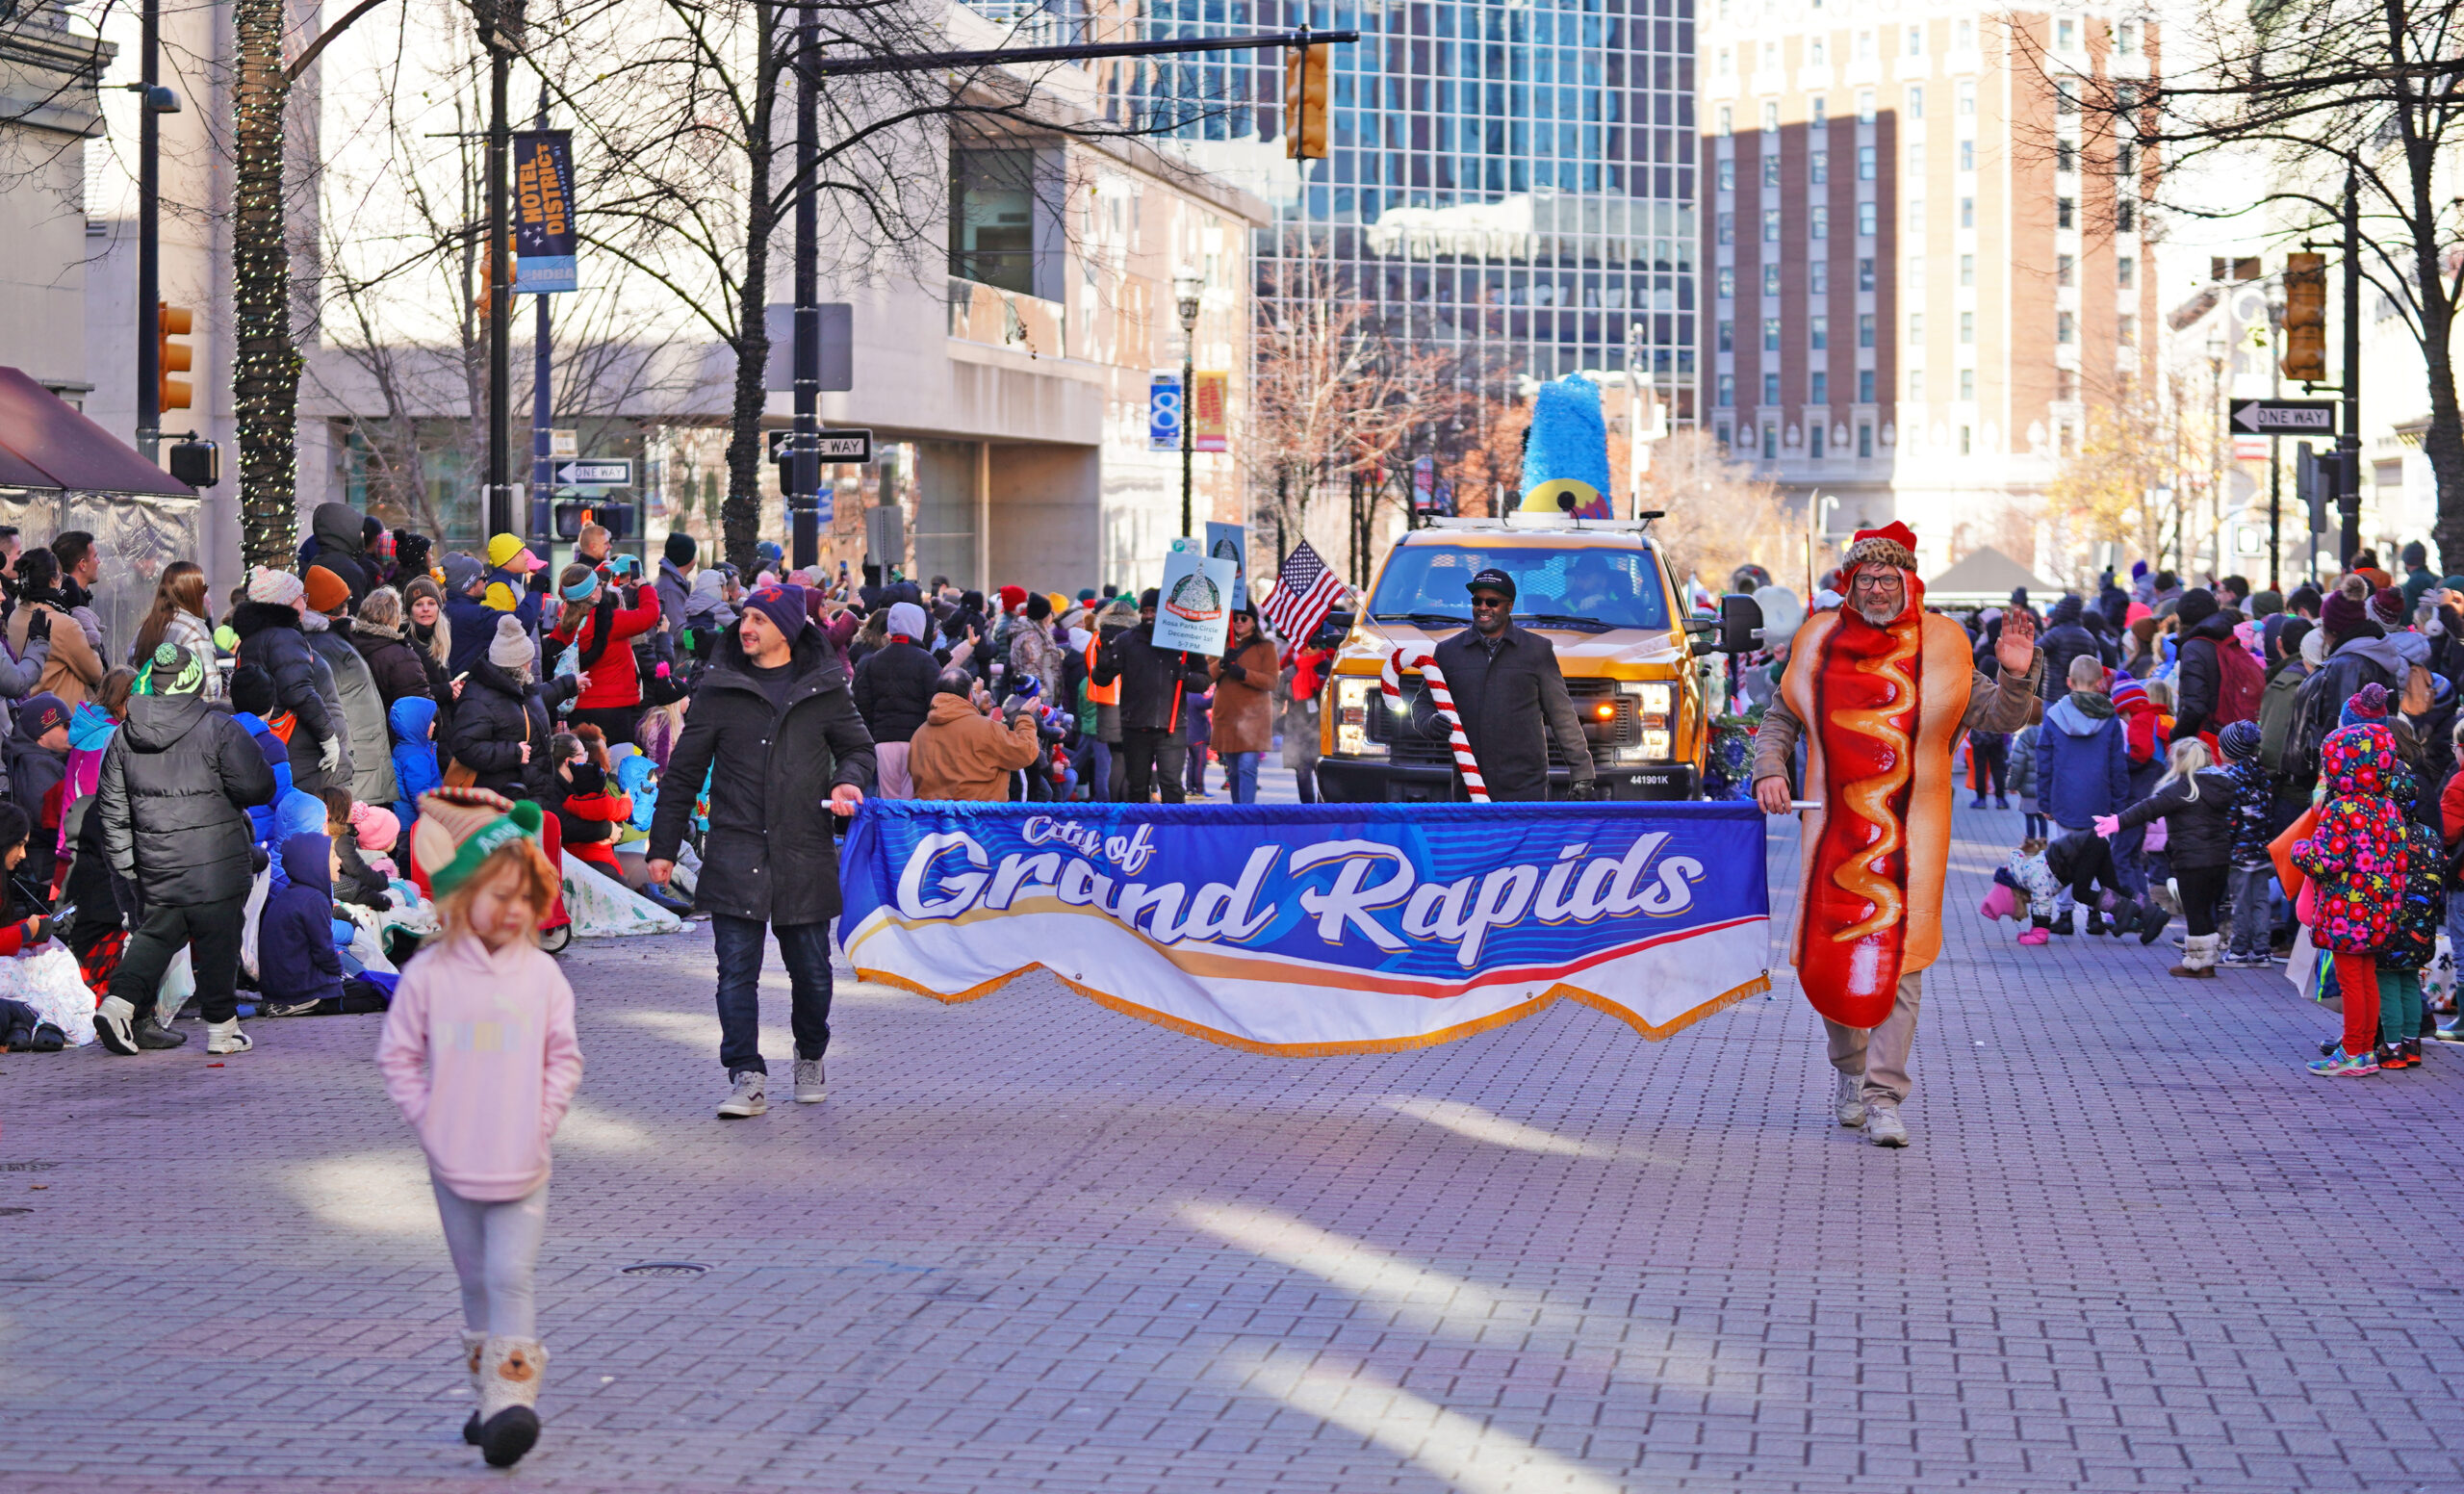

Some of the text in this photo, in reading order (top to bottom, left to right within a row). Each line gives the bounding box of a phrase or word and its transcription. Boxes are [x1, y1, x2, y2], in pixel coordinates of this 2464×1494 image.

[519, 158, 544, 223] HOTEL
[537, 142, 565, 236] DISTRICT
[1150, 392, 1181, 430] 8
[2256, 409, 2324, 425] ONE WAY
[830, 440, 860, 453] WAY
[575, 467, 623, 477] ONE WAY
[1162, 618, 1219, 634] Rosa Parks Circle
[1168, 630, 1202, 641] December
[1630, 775, 1669, 785] 441901K
[1022, 815, 1156, 876] City of
[896, 831, 1707, 970] Grand Rapids
